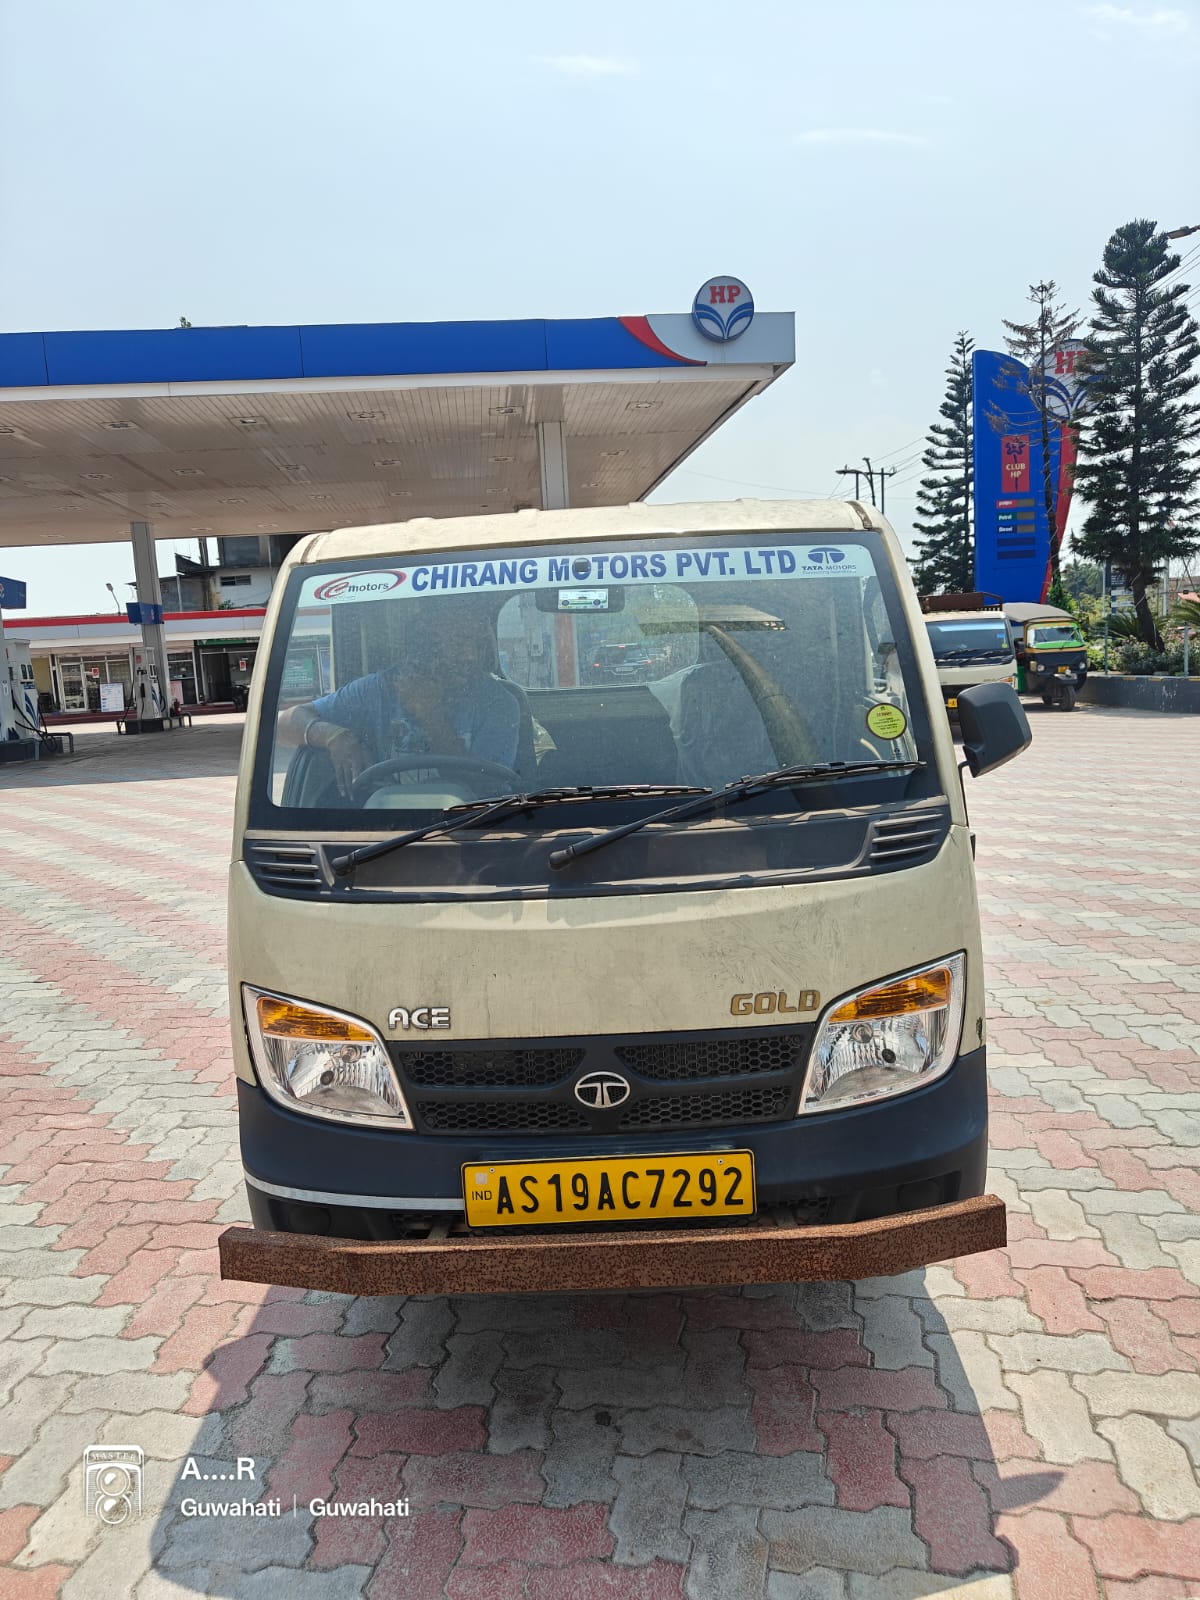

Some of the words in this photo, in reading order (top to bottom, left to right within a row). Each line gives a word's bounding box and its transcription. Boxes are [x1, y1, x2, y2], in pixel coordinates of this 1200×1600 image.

[709, 285, 741, 304] HP
[1006, 463, 1026, 471] CLUB
[1010, 470, 1022, 478] HP
[411, 560, 538, 592] CHIRANG
[548, 554, 667, 582] MOTORS
[676, 551, 735, 577] PVT.
[744, 550, 796, 575] LTD
[348, 583, 389, 593] motors
[730, 990, 821, 1016] GOLD
[388, 1007, 451, 1030] ACE
[471, 1190, 493, 1201] IND
[497, 1167, 744, 1214] AS19AC7292
